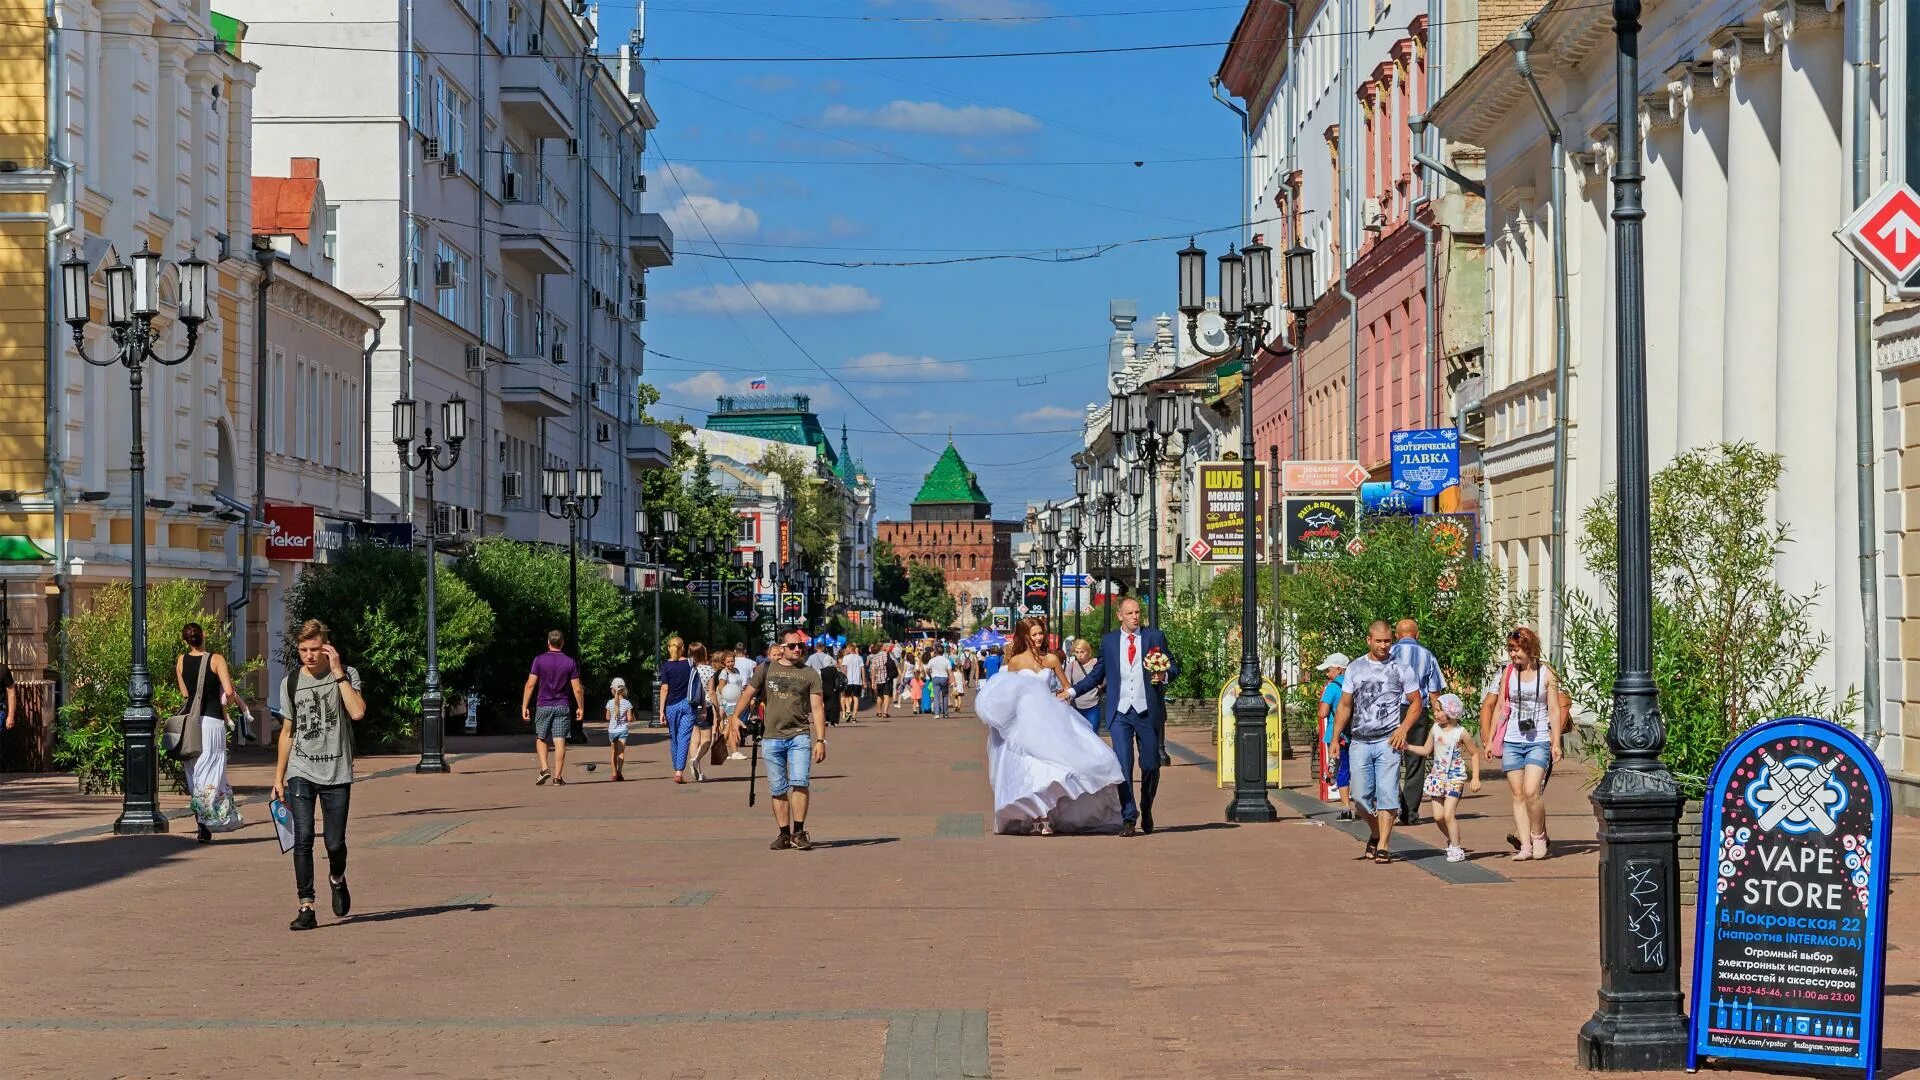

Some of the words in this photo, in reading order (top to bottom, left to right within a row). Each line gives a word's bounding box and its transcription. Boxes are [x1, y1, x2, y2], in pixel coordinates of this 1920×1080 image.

[1394, 441, 1457, 452] ЭЗОТЕРИЧЕСКАЯ
[1400, 453, 1450, 464] ЛАВКА
[265, 531, 312, 547] rieker
[1757, 845, 1834, 874] VAPE
[1743, 878, 1843, 910] STORE
[1734, 910, 1837, 931] Покровская
[1841, 918, 1861, 932] 22
[1717, 928, 1783, 943] (напротив
[1785, 933, 1862, 950] INTERMODA)
[1744, 947, 1798, 960] Огромный
[1800, 951, 1834, 963] выбор
[1718, 959, 1785, 972] электронных
[1787, 964, 1859, 977] испарителей,
[1718, 970, 1776, 983] жидкостей
[1777, 975, 1785, 984] и
[1787, 977, 1856, 990] аксессуаров
[1735, 986, 1783, 998] 433-45-46,
[1792, 990, 1817, 999] 11.00
[1830, 992, 1856, 1002] 23.00
